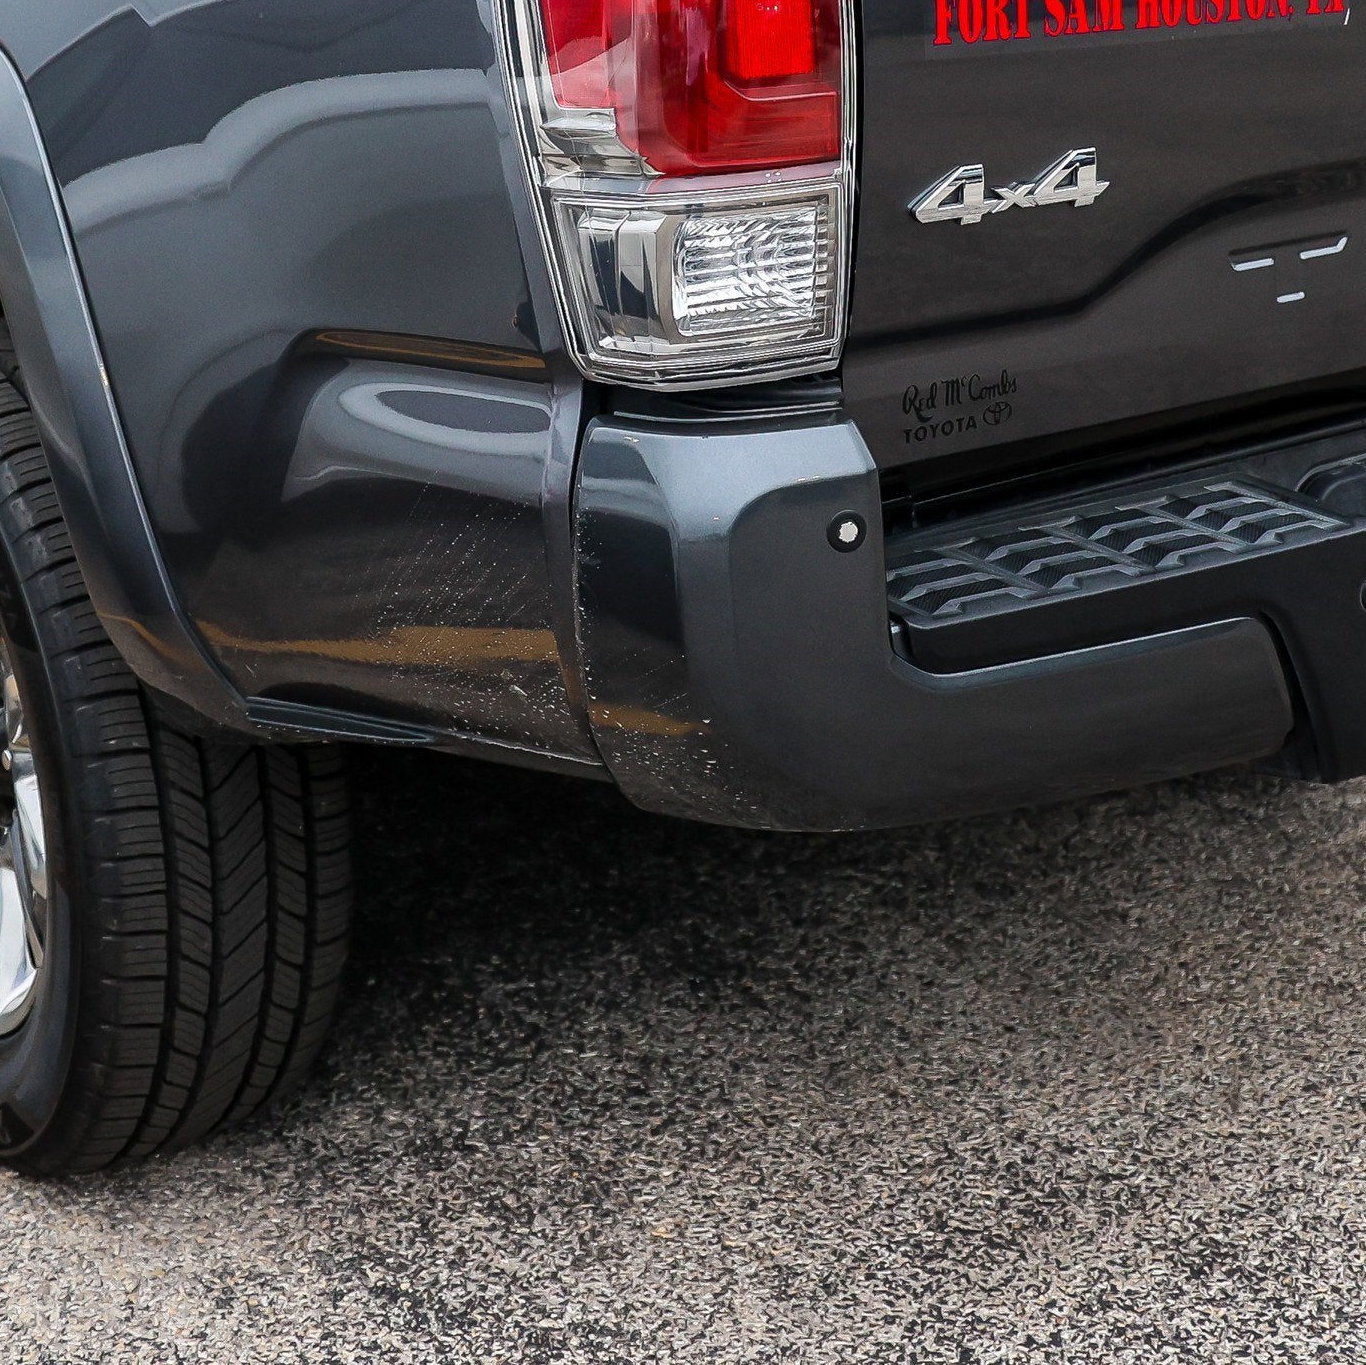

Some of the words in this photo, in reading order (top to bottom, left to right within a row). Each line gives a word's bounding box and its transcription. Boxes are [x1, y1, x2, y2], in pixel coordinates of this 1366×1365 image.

[907, 146, 1111, 226] 4x4
[902, 381, 938, 423] Red
[902, 415, 978, 445] TOYOTA
